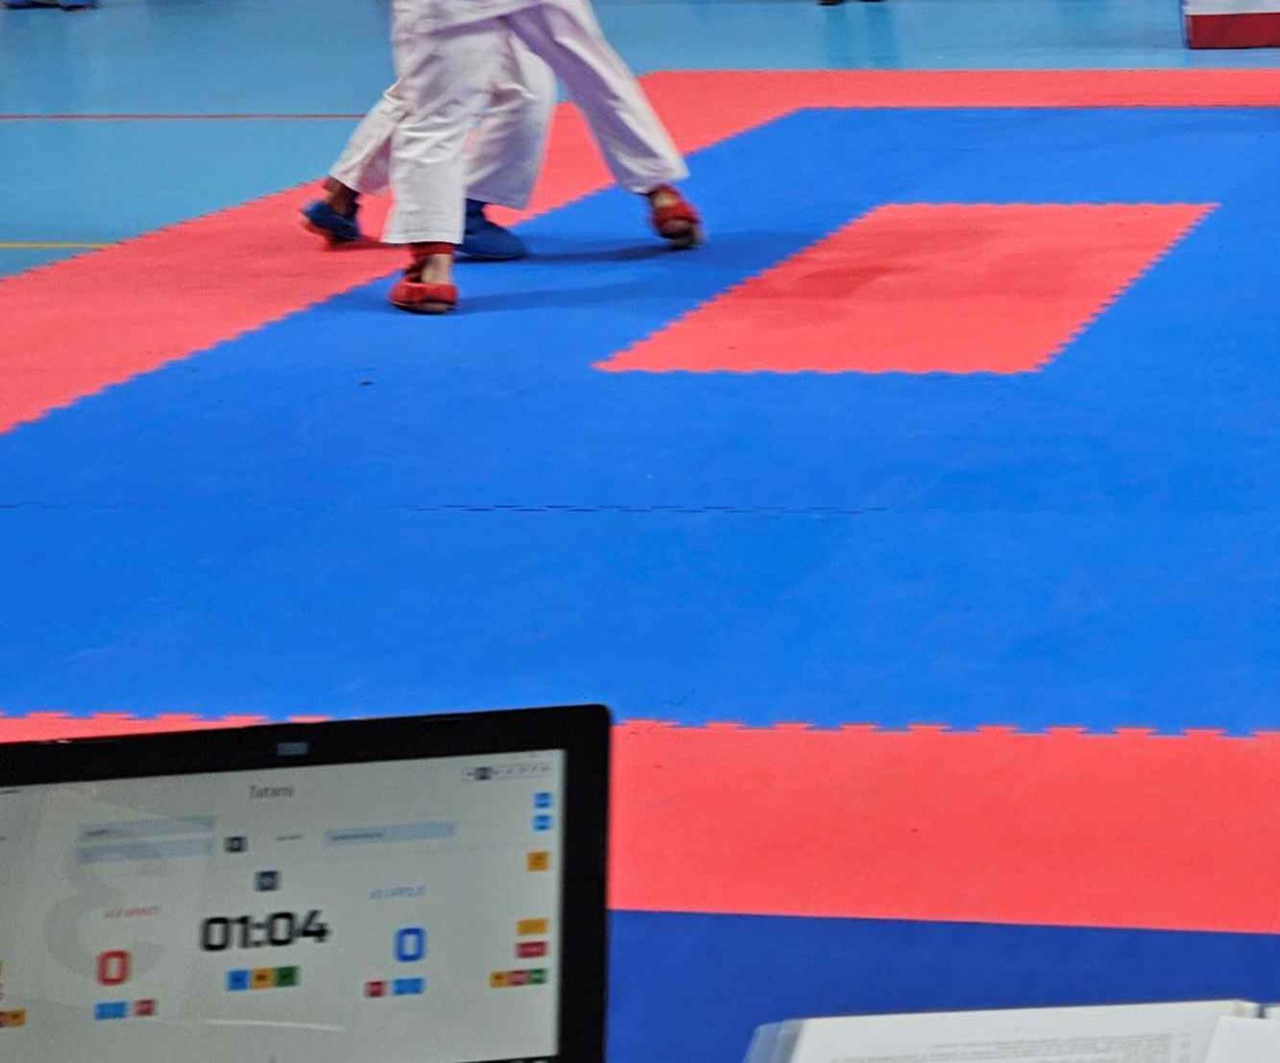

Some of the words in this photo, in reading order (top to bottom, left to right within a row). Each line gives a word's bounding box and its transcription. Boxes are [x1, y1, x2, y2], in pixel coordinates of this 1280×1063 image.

[201, 910, 328, 951] 01:04
[394, 927, 428, 963] 0
[97, 950, 130, 986] 0
